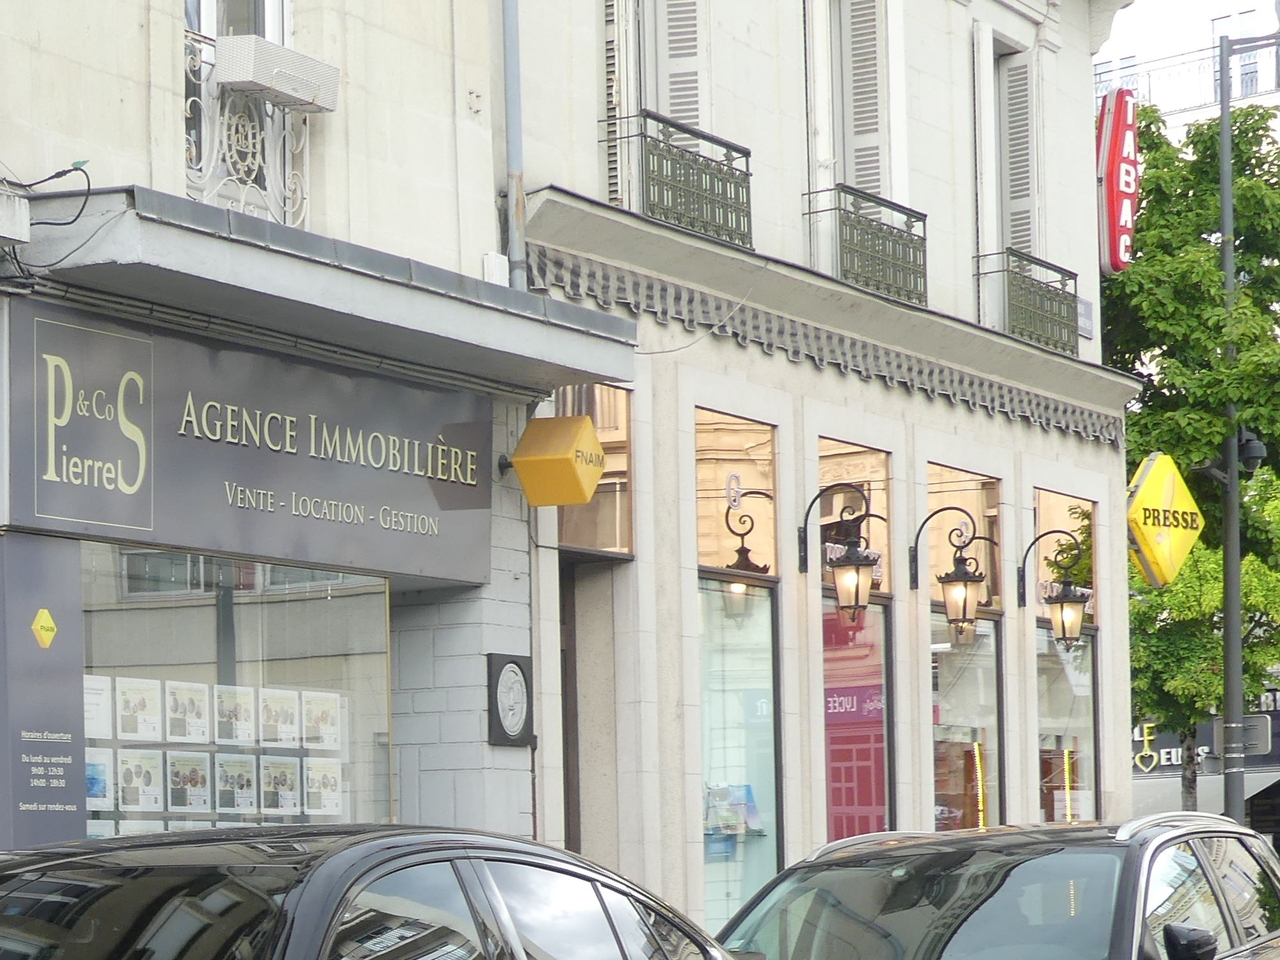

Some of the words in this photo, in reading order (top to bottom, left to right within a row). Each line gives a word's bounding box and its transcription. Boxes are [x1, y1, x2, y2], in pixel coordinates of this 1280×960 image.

[1119, 96, 1137, 263] TABAC
[76, 389, 90, 416] &
[177, 390, 298, 454] AGENCE
[308, 413, 478, 486] IMMOBILIÈRE
[575, 450, 605, 469] FNAIM
[224, 481, 275, 513] VENTE
[291, 491, 365, 525] LOCATION
[379, 505, 440, 536] GESTION
[1142, 507, 1200, 531] PRESSE
[21, 730, 43, 739] Horaires
[21, 754, 30, 762] Du
[30, 754, 43, 763] lundi
[51, 755, 73, 764] vendredi
[19, 802, 38, 811] Samedi
[47, 803, 77, 812] rendez-vous
